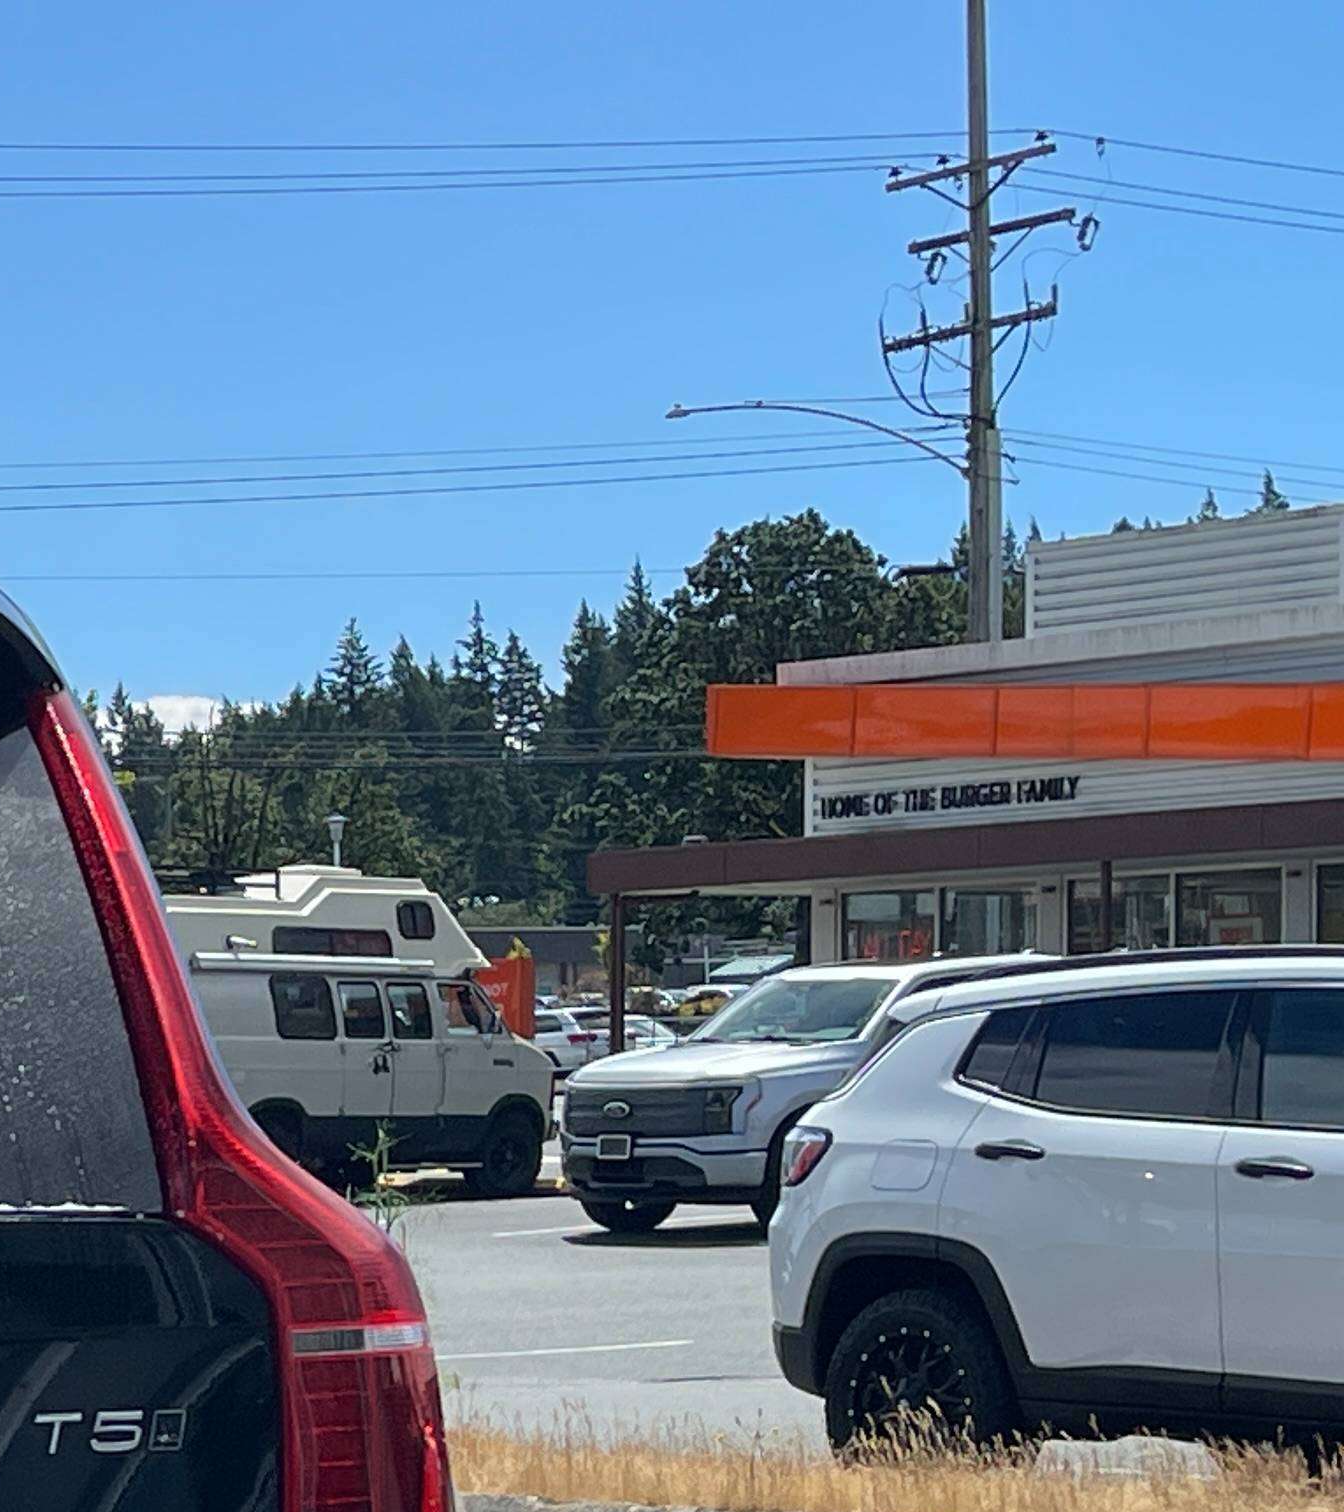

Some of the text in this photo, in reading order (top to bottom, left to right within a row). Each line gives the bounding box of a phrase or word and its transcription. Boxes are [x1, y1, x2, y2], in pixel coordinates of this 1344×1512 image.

[821, 776, 1080, 819] HOME OF THE BURGER FAMILY
[33, 1409, 144, 1455] T5
